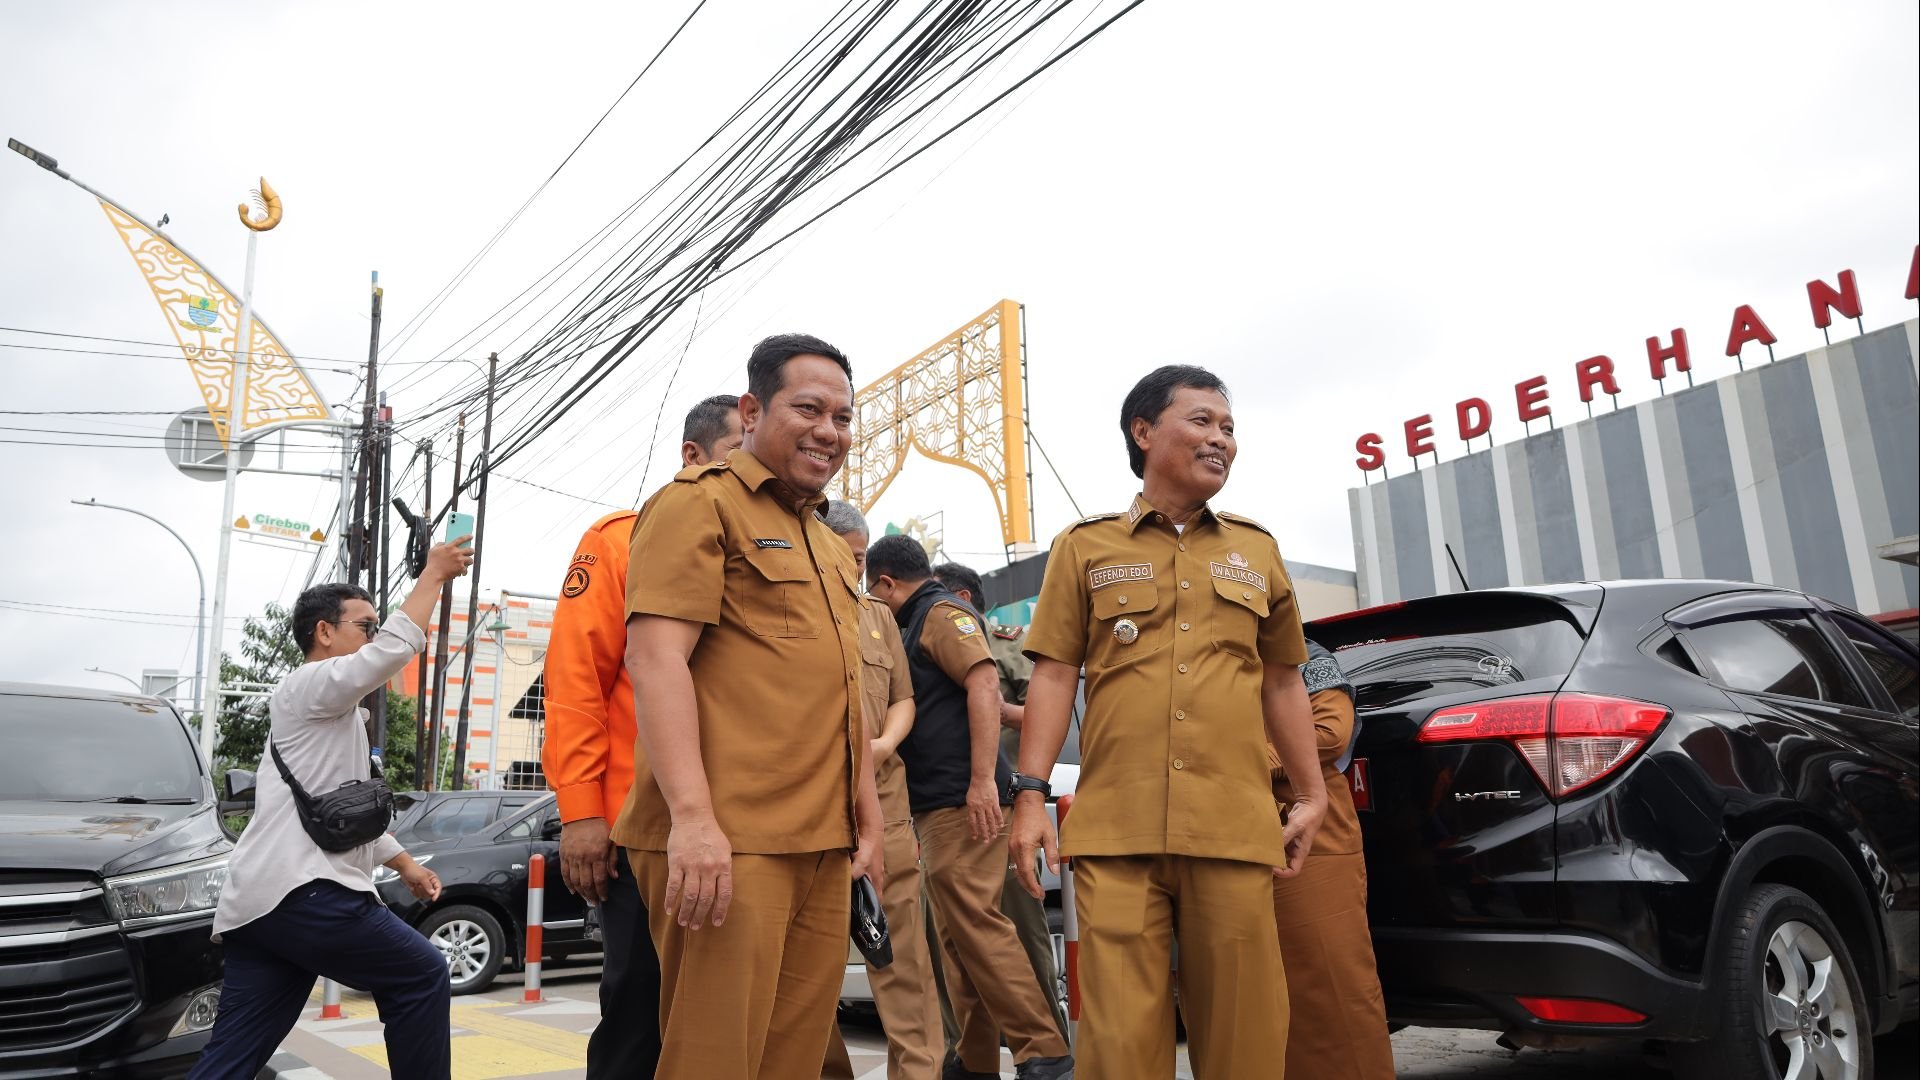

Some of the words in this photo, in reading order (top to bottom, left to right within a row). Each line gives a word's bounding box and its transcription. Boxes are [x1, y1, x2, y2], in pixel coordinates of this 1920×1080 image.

[255, 513, 311, 532] Cirebon
[261, 524, 302, 538] SETARA
[1093, 568, 1128, 584] EFFENDI
[1130, 566, 1149, 577] EDO
[1214, 565, 1263, 587] WALIKOTA
[1354, 763, 1365, 792] A
